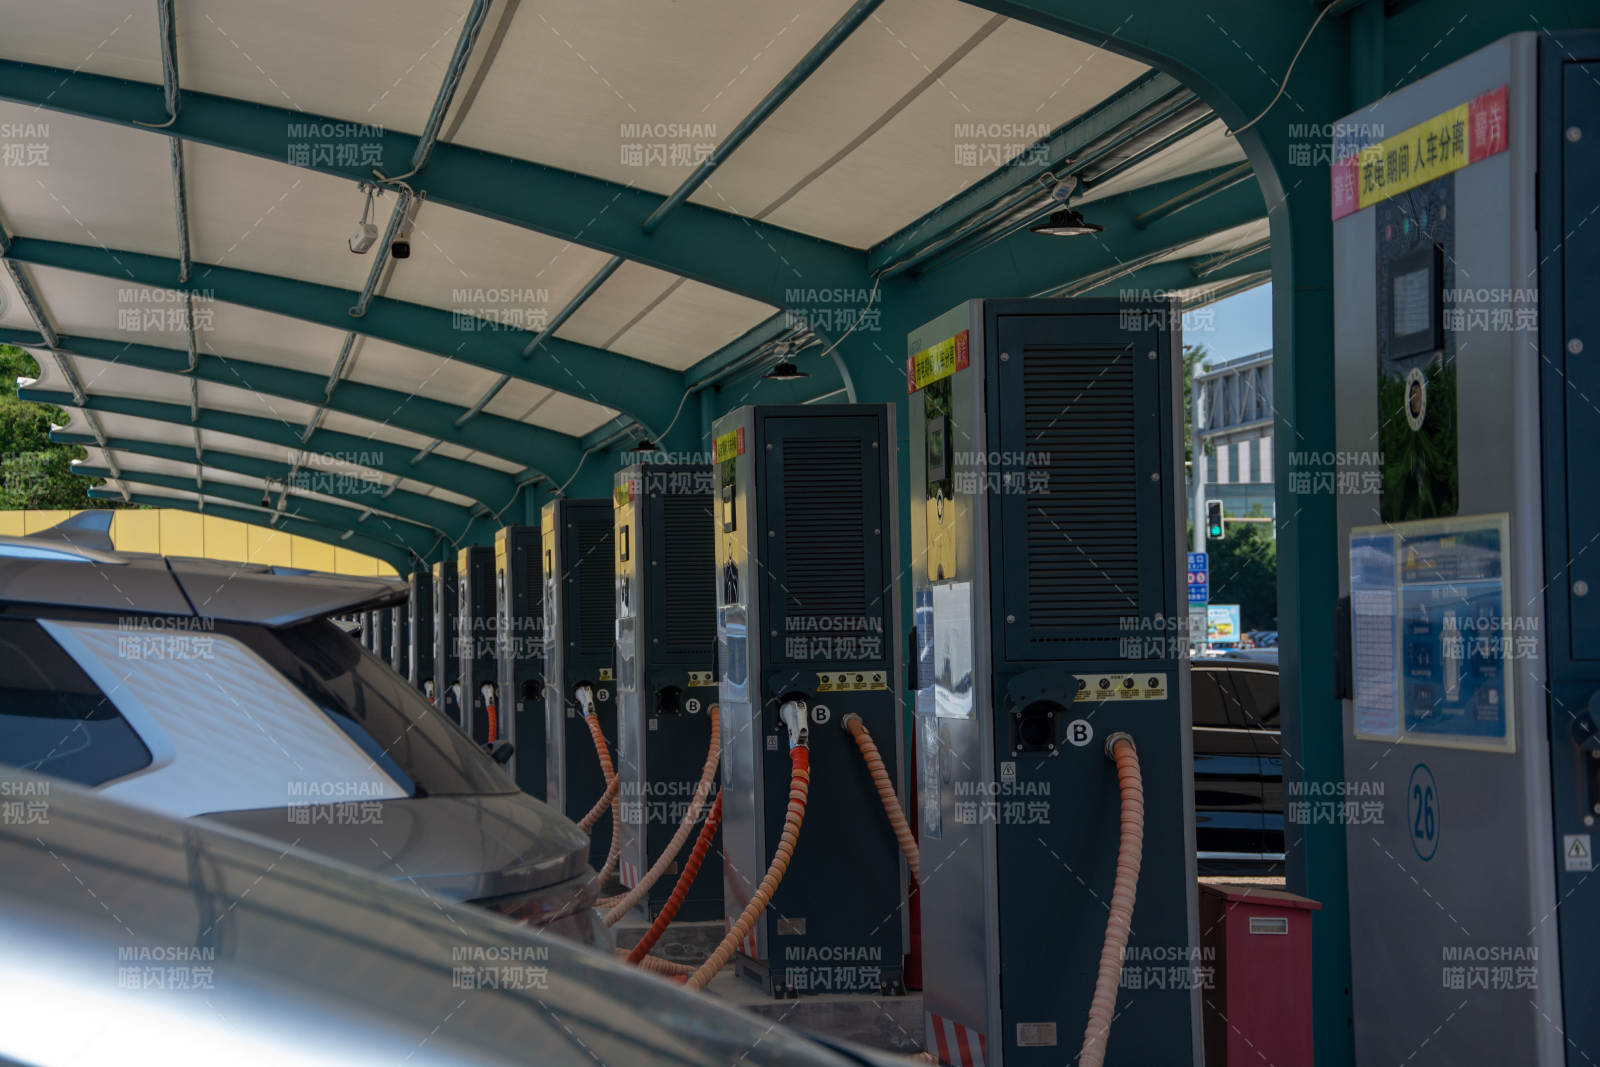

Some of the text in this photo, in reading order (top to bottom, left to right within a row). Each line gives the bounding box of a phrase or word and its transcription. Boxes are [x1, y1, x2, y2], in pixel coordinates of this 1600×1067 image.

[689, 701, 698, 711] B
[816, 708, 826, 721] B
[1073, 723, 1087, 742] B
[1413, 784, 1434, 840] 26
